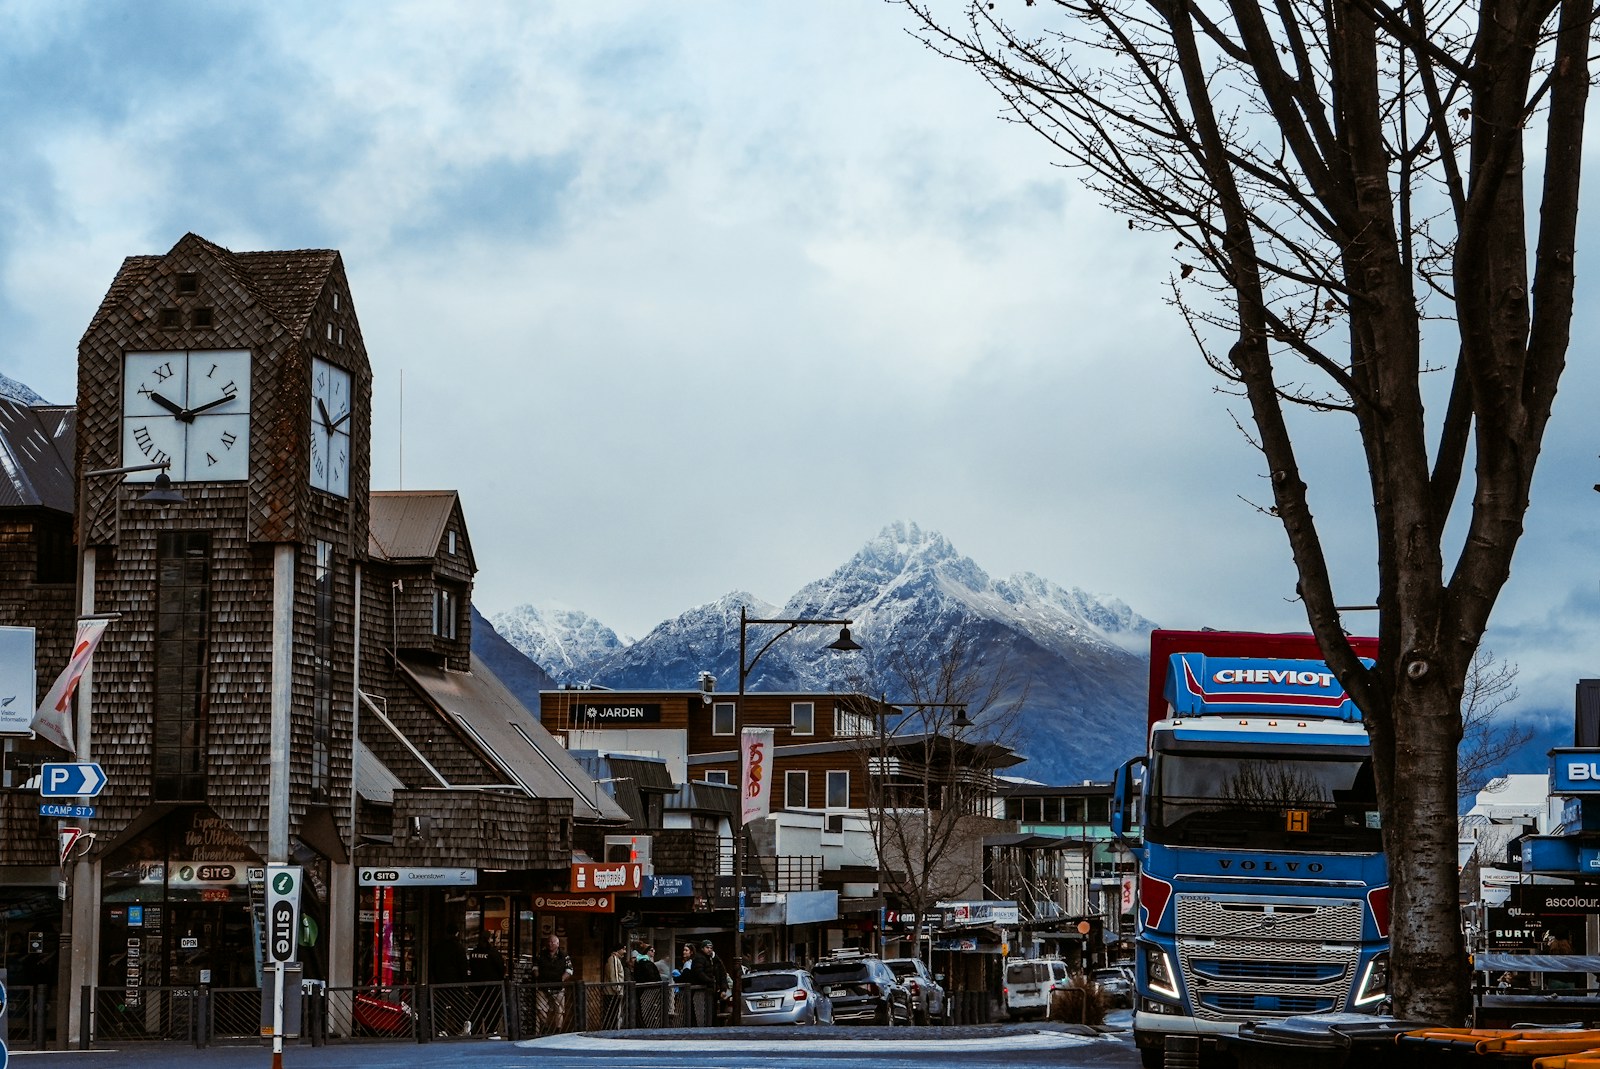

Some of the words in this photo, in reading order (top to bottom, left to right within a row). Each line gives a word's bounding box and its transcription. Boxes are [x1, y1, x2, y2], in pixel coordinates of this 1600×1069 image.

[1214, 669, 1335, 688] CHEVIOT
[599, 707, 644, 718] JARDEN
[51, 768, 70, 792] P
[48, 805, 72, 815] CAMP
[75, 807, 86, 816] ST
[1289, 810, 1305, 831] H
[192, 846, 245, 861] Adventure
[1217, 859, 1323, 873] VOLVO
[408, 872, 446, 880] Queenstown
[1545, 895, 1600, 908] ascolour.
